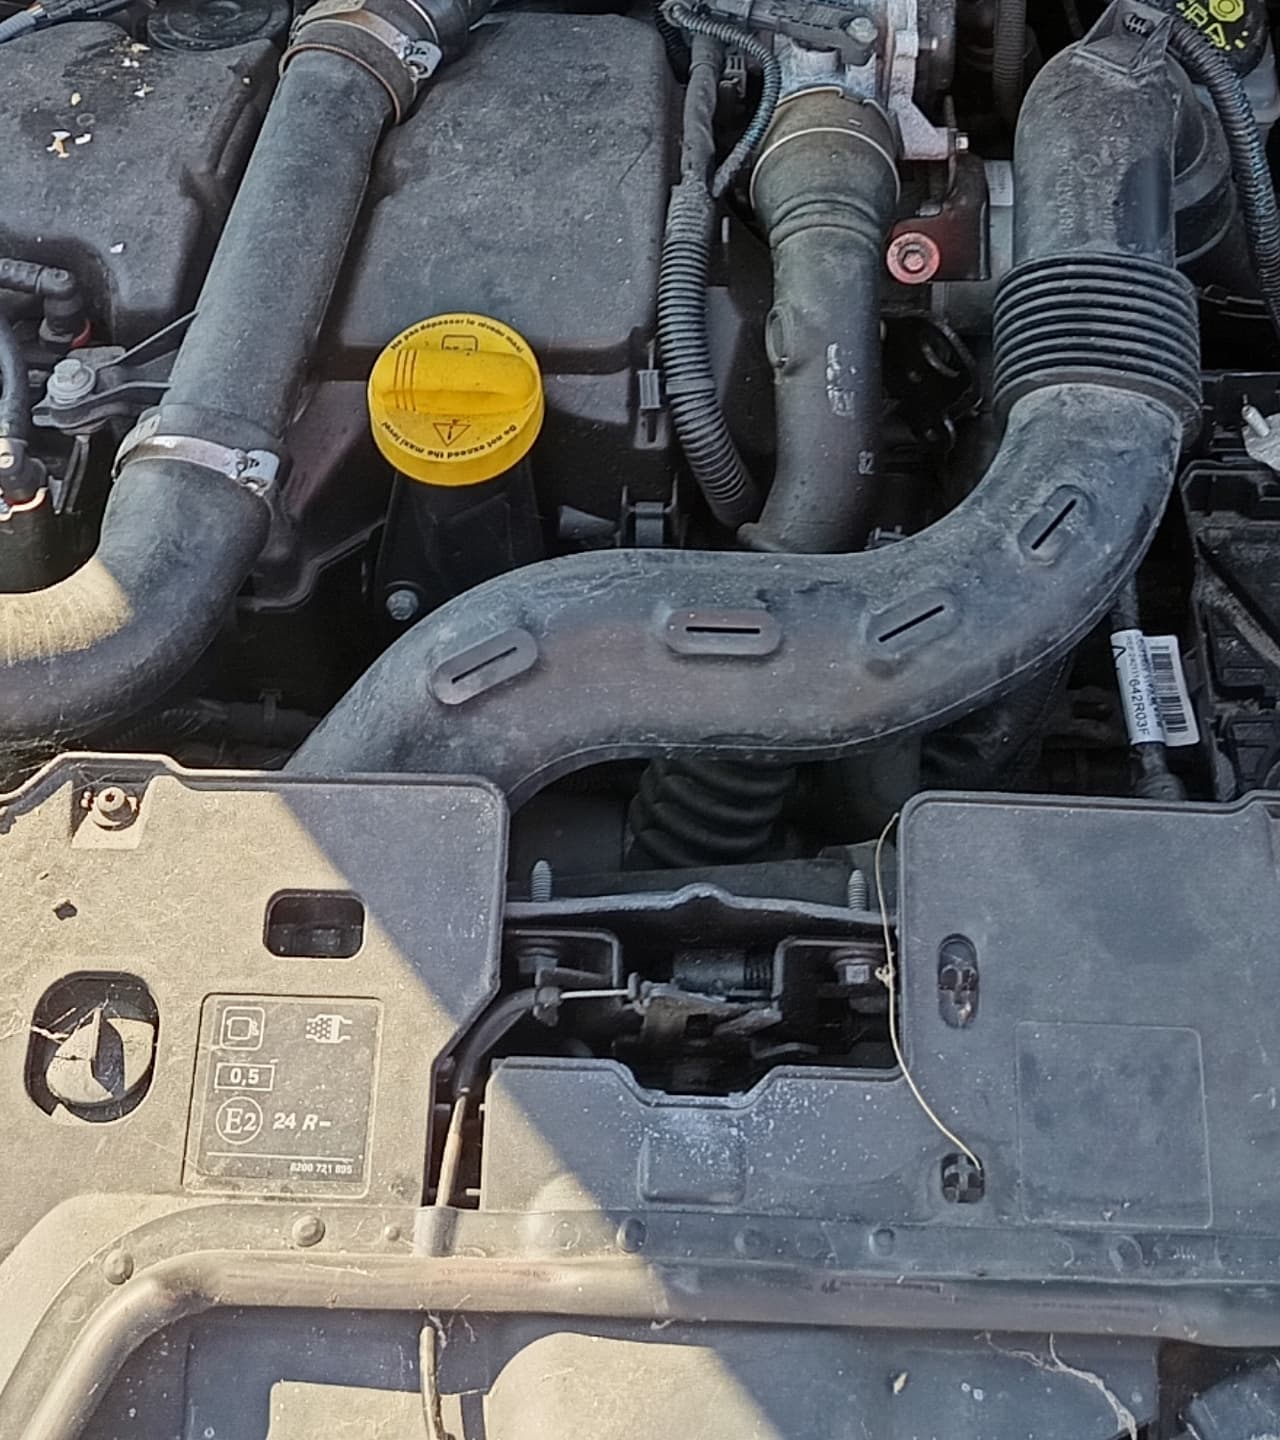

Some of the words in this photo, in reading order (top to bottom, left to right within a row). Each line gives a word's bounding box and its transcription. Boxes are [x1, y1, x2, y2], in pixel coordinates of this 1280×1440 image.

[390, 338, 403, 350] Ne
[404, 328, 420, 341] pas
[467, 318, 476, 326] le
[478, 321, 505, 337] niveau
[506, 335, 523, 353] maxi
[382, 421, 402, 441] level
[503, 424, 517, 436] Do
[400, 439, 424, 454] maxi
[486, 436, 504, 449] not
[427, 449, 444, 458] the
[447, 444, 486, 458] exceed
[229, 1069, 261, 1086] 0,5
[223, 1108, 258, 1135] E2
[272, 1112, 297, 1130] 24
